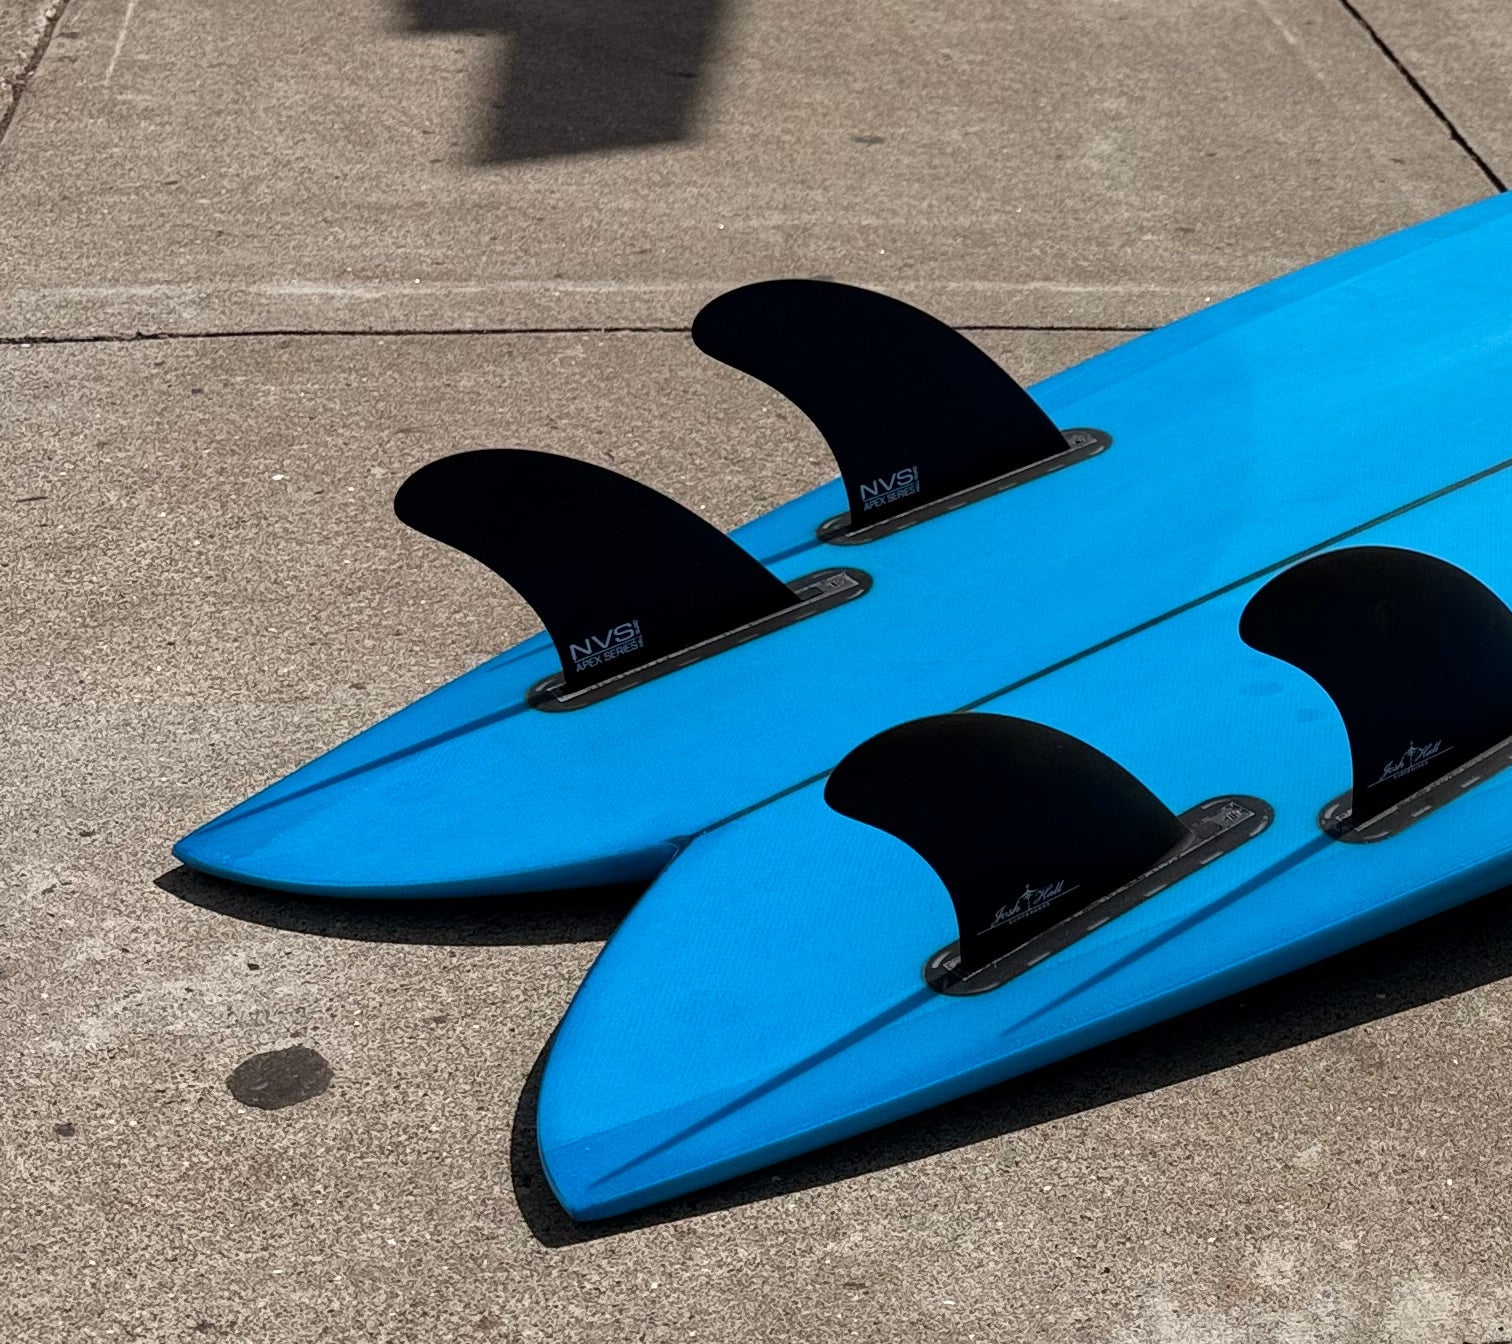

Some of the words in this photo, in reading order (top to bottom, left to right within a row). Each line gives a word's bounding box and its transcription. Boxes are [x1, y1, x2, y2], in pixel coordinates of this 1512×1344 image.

[860, 468, 914, 500] NVS
[569, 622, 635, 660] NVS
[576, 655, 603, 672] APEX
[603, 641, 639, 661] SERIES
